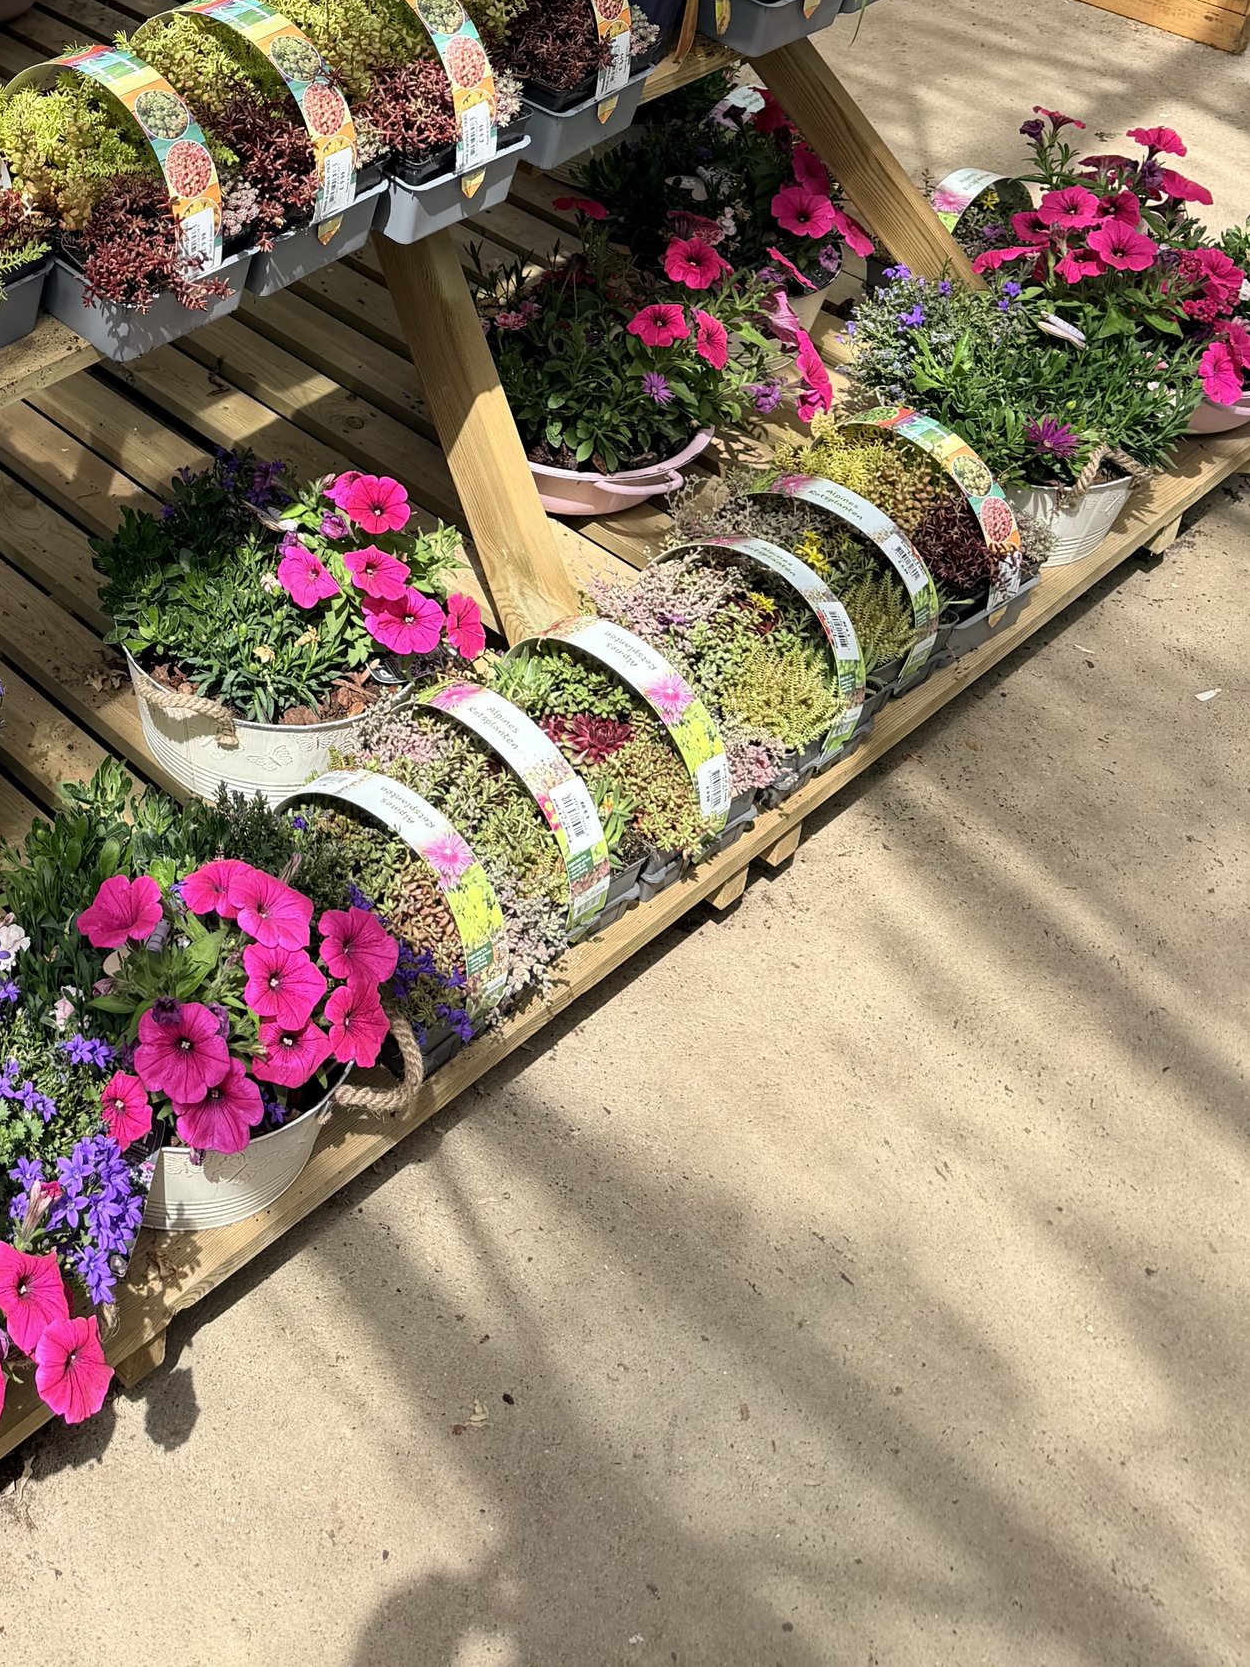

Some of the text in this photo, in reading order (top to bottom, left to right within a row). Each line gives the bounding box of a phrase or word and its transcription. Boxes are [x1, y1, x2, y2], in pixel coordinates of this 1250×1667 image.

[824, 486, 859, 510] Alpines
[603, 628, 657, 673] Rotsplanten
[603, 640, 638, 669] Alpines
[466, 703, 521, 750] Rotsplanten
[486, 703, 520, 734] Alpines
[378, 784, 436, 831] Rotsplanten
[379, 795, 415, 826] Alpines
